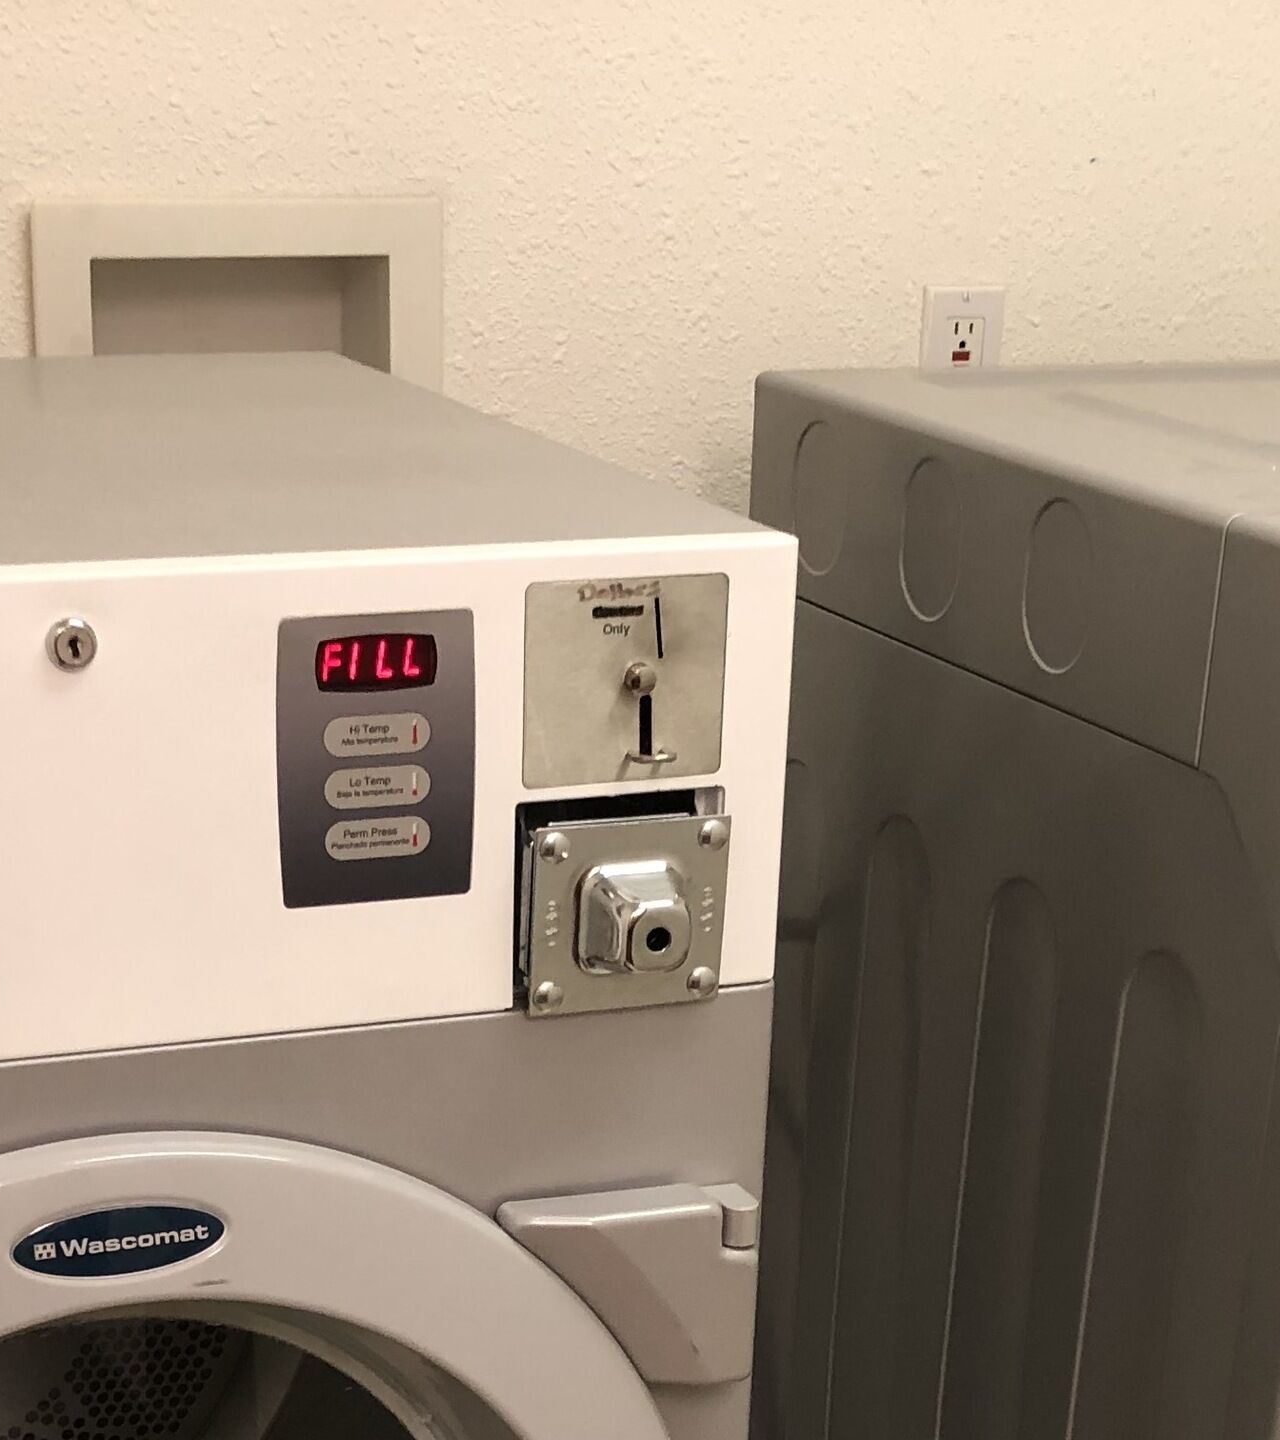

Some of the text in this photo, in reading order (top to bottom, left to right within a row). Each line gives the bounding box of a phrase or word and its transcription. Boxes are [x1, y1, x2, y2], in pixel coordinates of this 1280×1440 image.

[602, 622, 631, 637] Only
[322, 638, 420, 682] FILL
[349, 724, 390, 735] Hi Temp
[349, 776, 392, 787] Lo Temp
[343, 827, 398, 839] Perm Press
[60, 1224, 210, 1257] Wascomat
